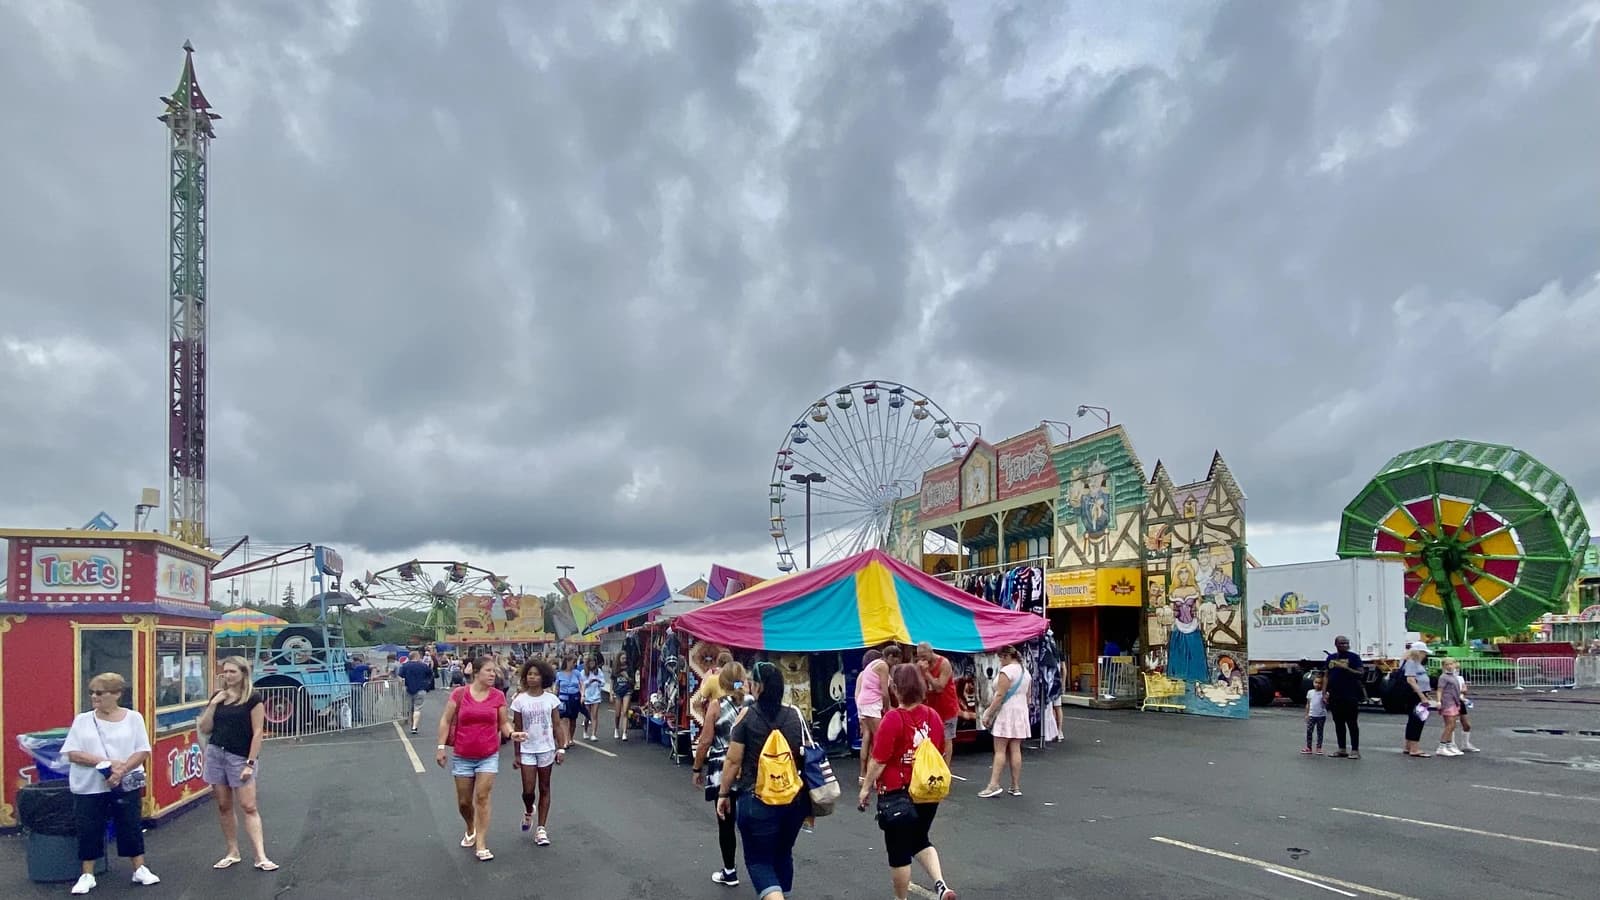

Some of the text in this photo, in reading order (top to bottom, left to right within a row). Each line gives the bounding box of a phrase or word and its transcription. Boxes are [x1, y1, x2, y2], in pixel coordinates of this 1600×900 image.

[39, 555, 118, 588] TICKETS
[1253, 604, 1330, 628] STRATES SHOWS
